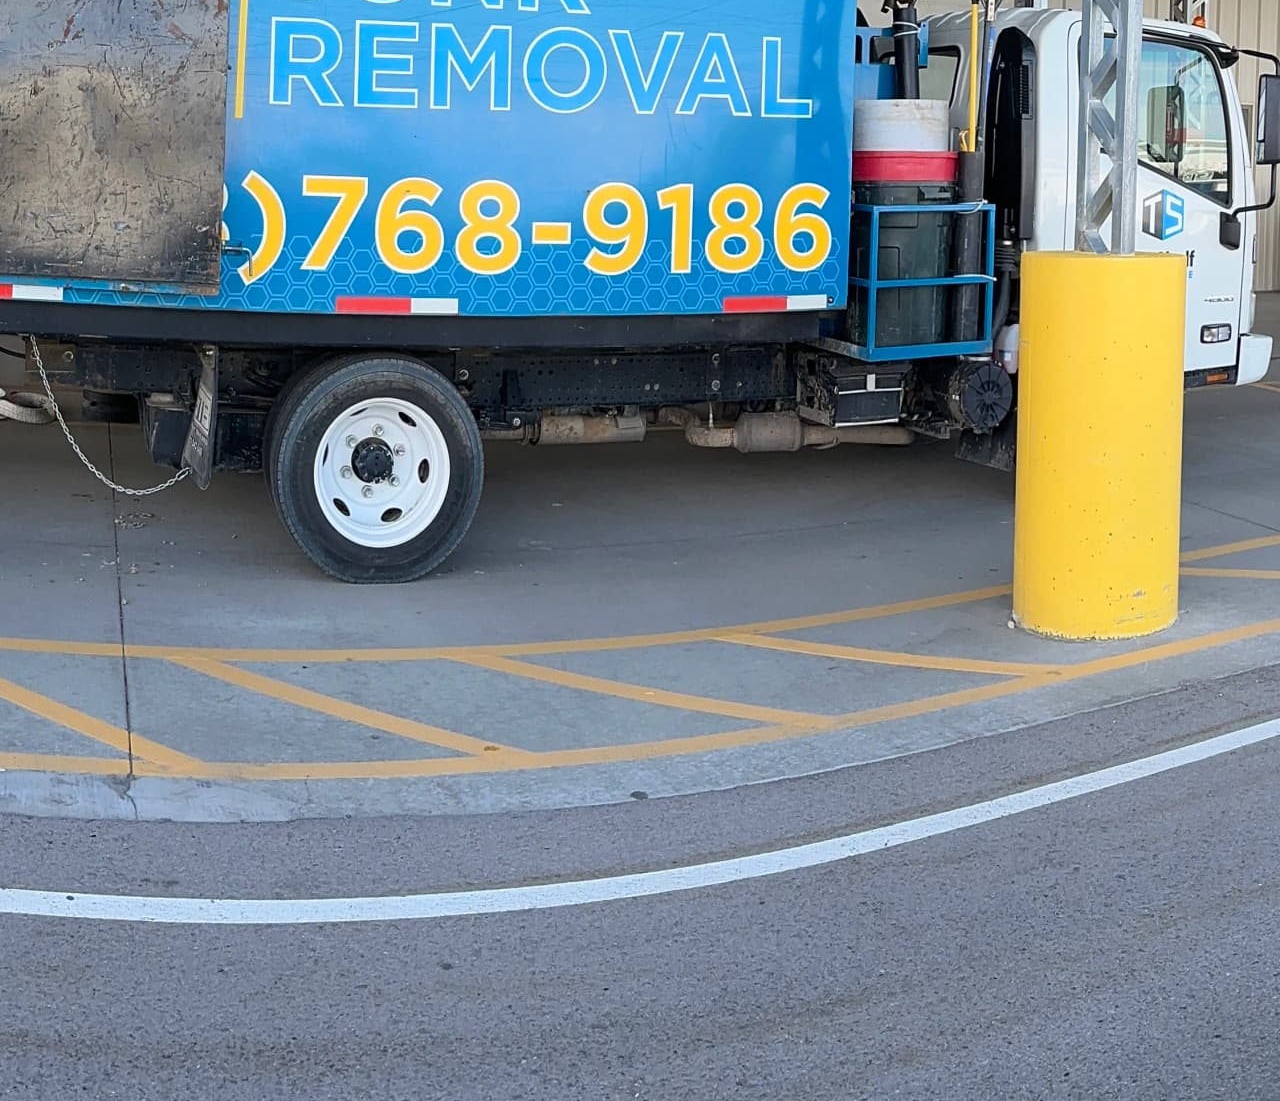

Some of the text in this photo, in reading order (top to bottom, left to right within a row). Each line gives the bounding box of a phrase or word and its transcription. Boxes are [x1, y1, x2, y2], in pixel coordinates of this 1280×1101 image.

[269, 17, 814, 119] REMOVAL
[221, 169, 832, 286] )768-9186
[1143, 193, 1183, 237] TS
